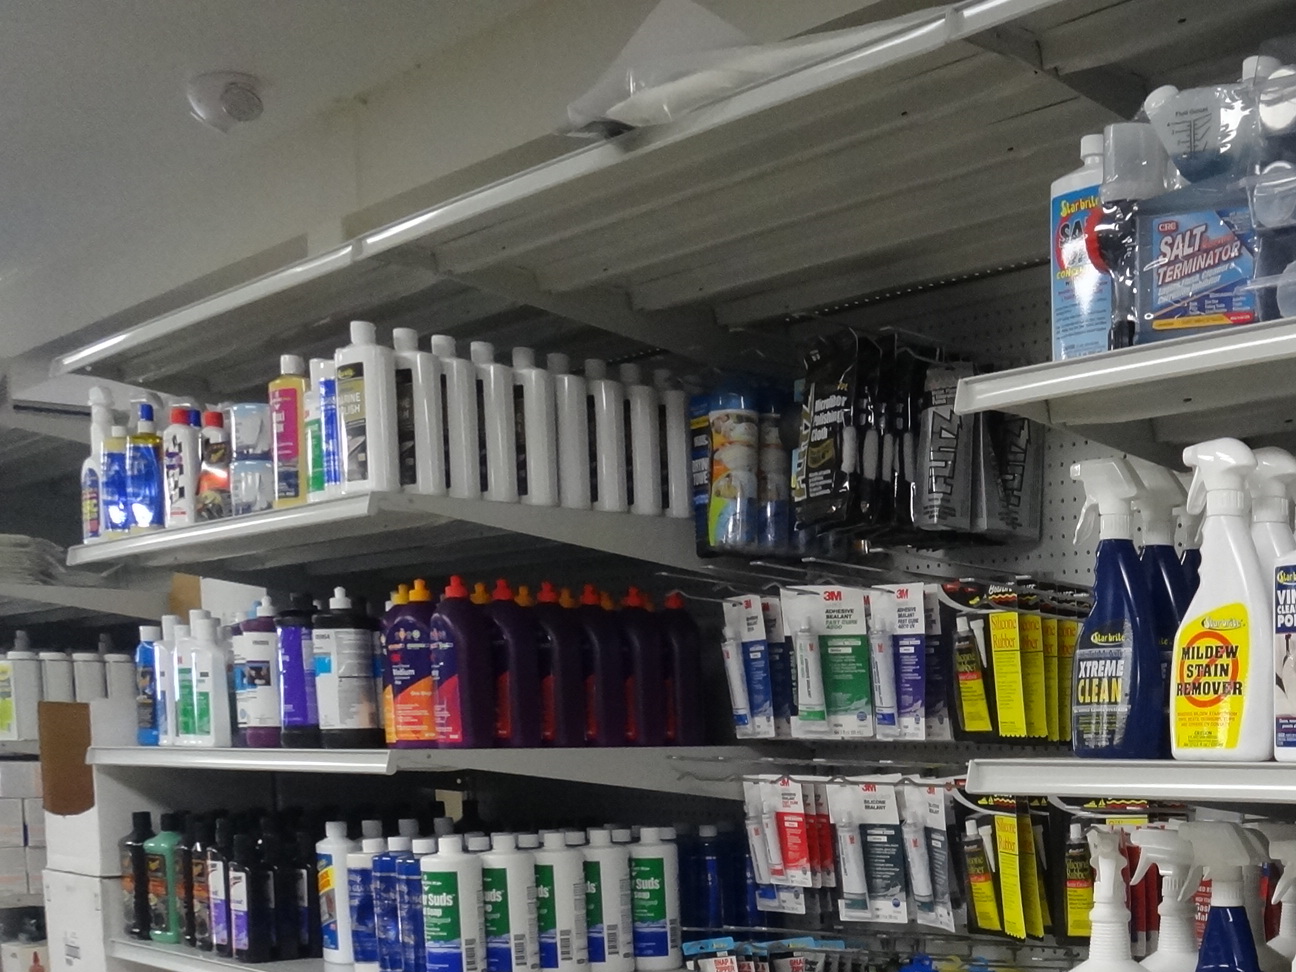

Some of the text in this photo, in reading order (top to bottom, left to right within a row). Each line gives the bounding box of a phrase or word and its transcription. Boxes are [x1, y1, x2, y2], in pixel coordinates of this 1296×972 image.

[1160, 224, 1208, 261] SALT
[1157, 240, 1241, 286] TERMINATOR
[823, 590, 842, 601] 3M
[896, 588, 909, 600] 3M
[990, 616, 1018, 632] Silicone
[991, 632, 1017, 647] Rubber
[1181, 645, 1239, 660] MILDEW
[1078, 660, 1124, 678] XTREME
[1186, 663, 1230, 678] STAIN
[1078, 678, 1122, 704] CLEAN
[1176, 680, 1243, 697] REMOVER
[863, 798, 887, 806] SILICONE
[998, 836, 1017, 851] Rubber
[636, 878, 660, 891] Suds
[428, 893, 453, 907] Suds
[713, 957, 729, 967] SNAP
